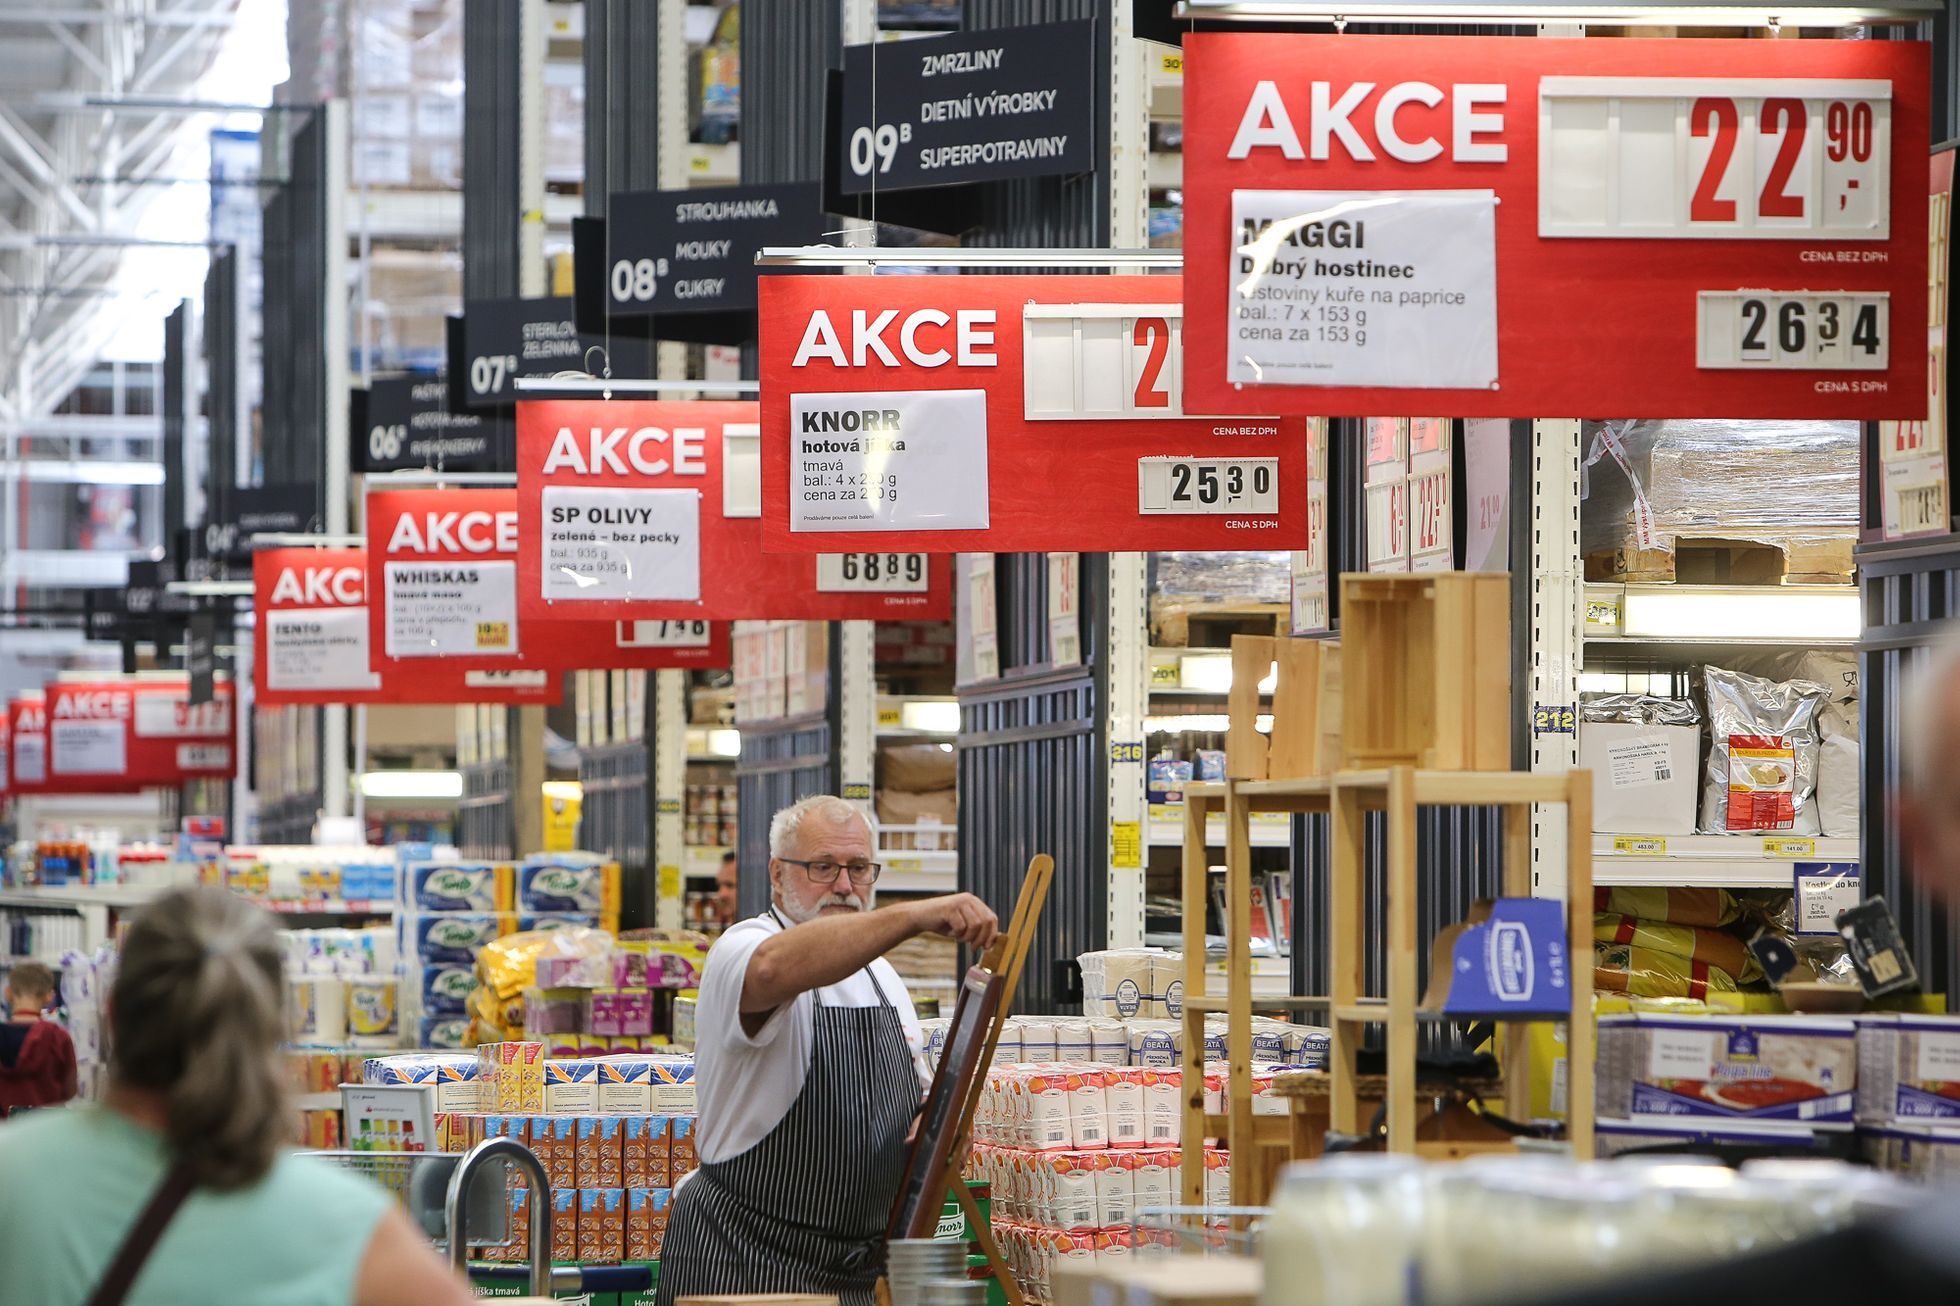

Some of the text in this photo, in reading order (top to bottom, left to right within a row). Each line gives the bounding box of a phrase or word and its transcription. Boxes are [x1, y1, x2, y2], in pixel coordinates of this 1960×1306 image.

[921, 48, 1004, 77] ZMRZLINY
[921, 89, 1057, 124] DIETNÍ VÝROBKY
[1227, 79, 1508, 164] AKCE
[920, 135, 1068, 170] SUPERPOTRAVINY
[676, 198, 779, 223] STROUHANKA
[675, 240, 733, 261] MOUKY
[1800, 250, 1889, 263] CENA BEZ DPH
[1240, 256, 1415, 280] Dbrý hostinec
[674, 278, 725, 299] CUKRY
[1326, 285, 1365, 303] kuře
[1371, 290, 1393, 303] na
[1400, 288, 1466, 308] paprice
[1240, 304, 1367, 326] bal.: 7 x 153 g
[791, 308, 998, 368] AKCE
[1239, 327, 1367, 346] cena za 153 g
[1133, 317, 1169, 409] 2
[1814, 381, 1888, 393] CENA S DPH
[801, 409, 901, 433] KNORR
[1213, 427, 1277, 436] CENA BEZ DPH
[542, 426, 707, 475] AKCE
[802, 438, 861, 453] hotová
[803, 459, 843, 471] tmavá
[804, 472, 897, 487] bal.: 4 x 20 g
[803, 487, 897, 501] cena za 20 g
[551, 507, 652, 524] SP OLIVY
[387, 511, 518, 553] AKCE
[1225, 520, 1278, 529] CENA S DPH
[551, 530, 596, 541] zelené
[612, 532, 636, 542] bez
[640, 532, 680, 544] pecky
[577, 548, 598, 559] 935
[600, 551, 608, 560] g
[580, 563, 593, 571] za
[394, 569, 479, 584] WHISKAS
[270, 566, 368, 606] AKC
[54, 692, 131, 721] AKCE
[1535, 711, 1575, 729] 212
[1112, 745, 1142, 760] 216
[1146, 1041, 1171, 1049] BEATA
[1256, 1041, 1280, 1049] BEATA
[1306, 1042, 1329, 1050] BEATA
[940, 1221, 963, 1233] norr
[495, 1286, 520, 1296] tmavá
